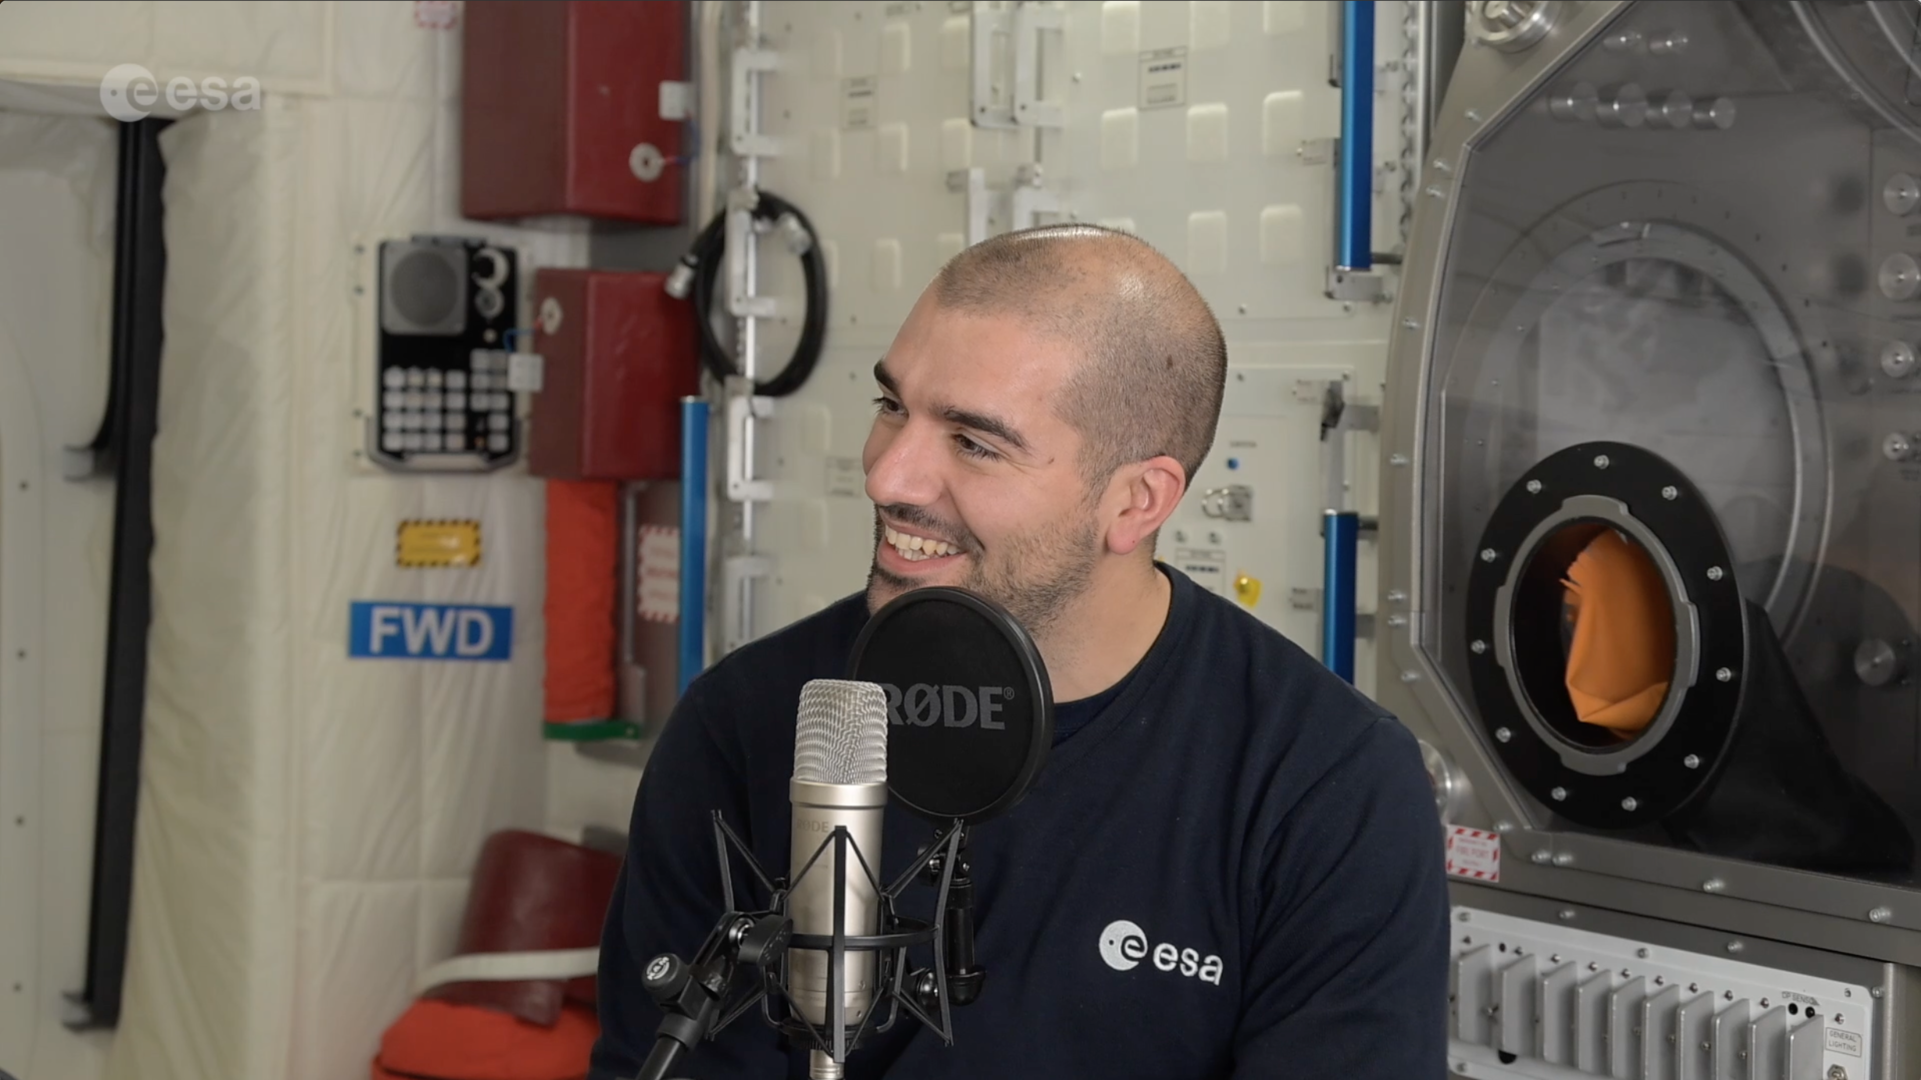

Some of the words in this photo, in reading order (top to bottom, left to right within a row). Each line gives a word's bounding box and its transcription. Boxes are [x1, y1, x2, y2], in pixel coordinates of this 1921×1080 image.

[369, 605, 495, 656] FWD
[1153, 943, 1223, 986] esa
[1828, 1040, 1857, 1052] LIGHTING
[1829, 1030, 1857, 1043] GENERAL
